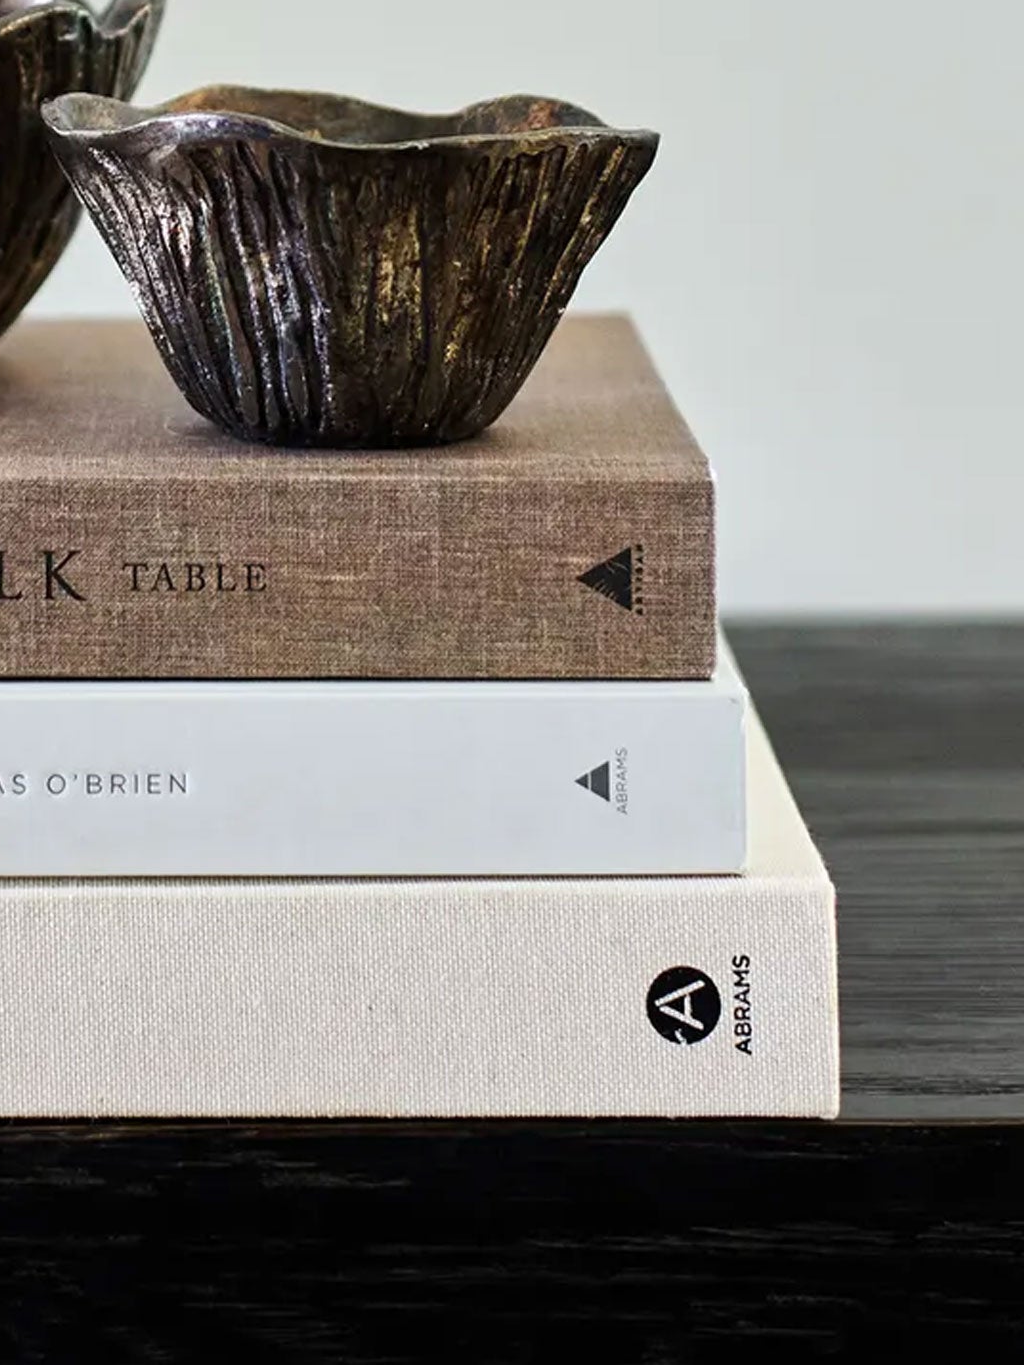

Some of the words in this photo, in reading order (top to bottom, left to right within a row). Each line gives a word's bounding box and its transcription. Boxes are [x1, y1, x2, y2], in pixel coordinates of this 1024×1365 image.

[121, 562, 267, 594] TABLE
[44, 772, 188, 796] O'BRIEN
[615, 747, 628, 816] ABRAMS
[732, 955, 752, 1055] ABRAMS
